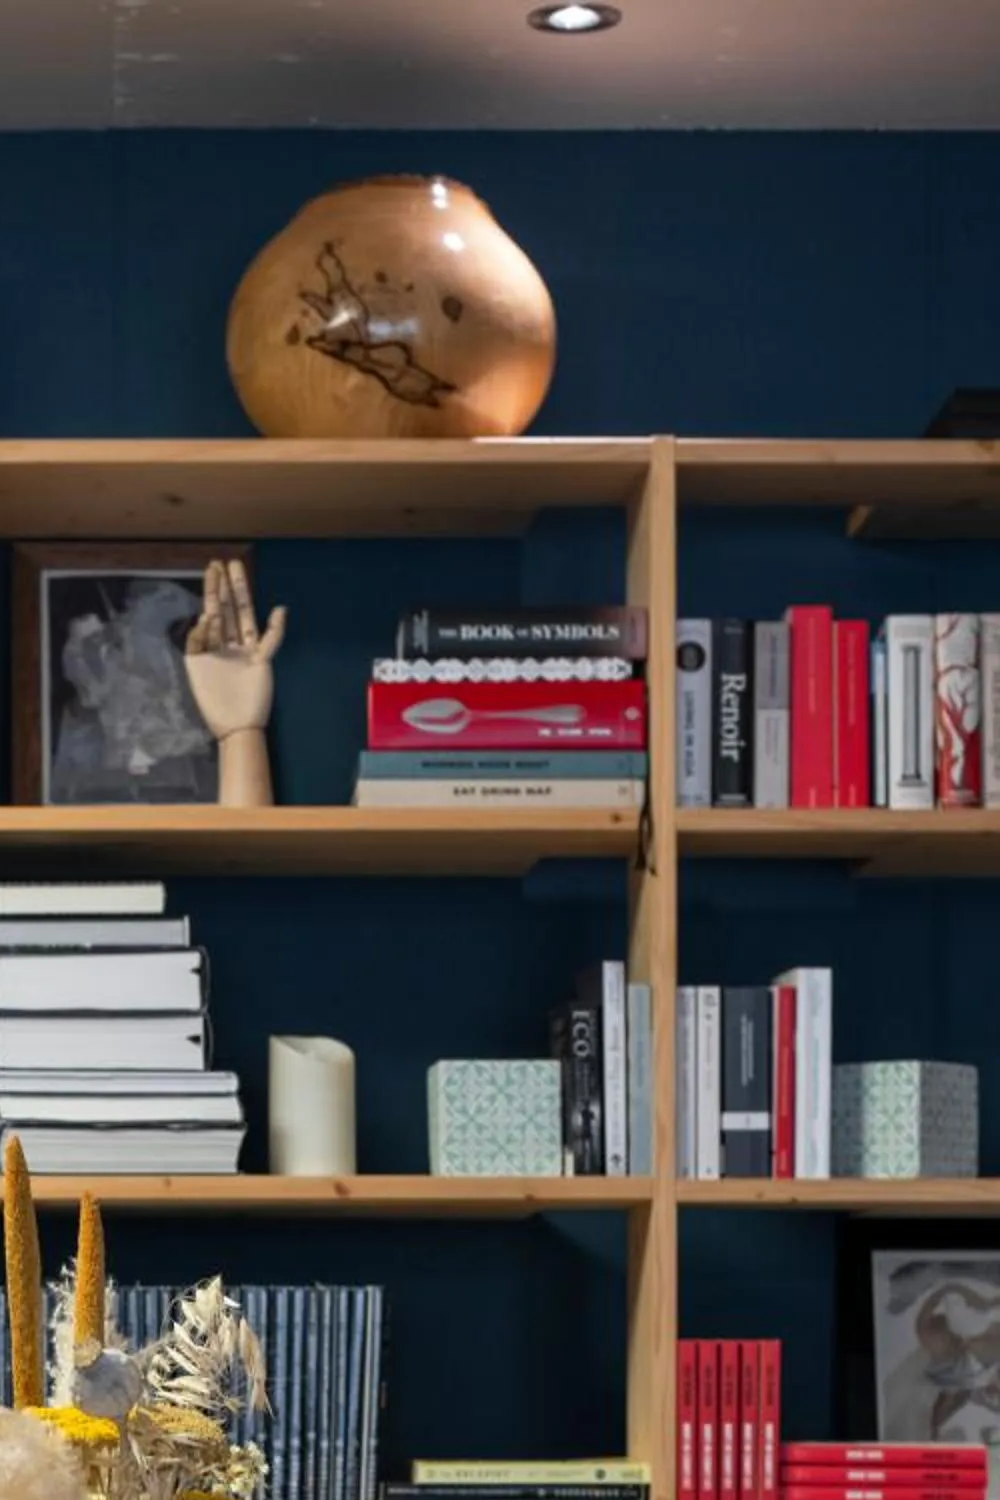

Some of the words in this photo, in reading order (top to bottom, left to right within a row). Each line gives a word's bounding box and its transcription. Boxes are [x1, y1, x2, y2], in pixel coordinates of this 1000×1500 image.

[460, 624, 515, 641] BOOK
[530, 624, 620, 641] SYMBOLS
[721, 673, 747, 763] Renoir
